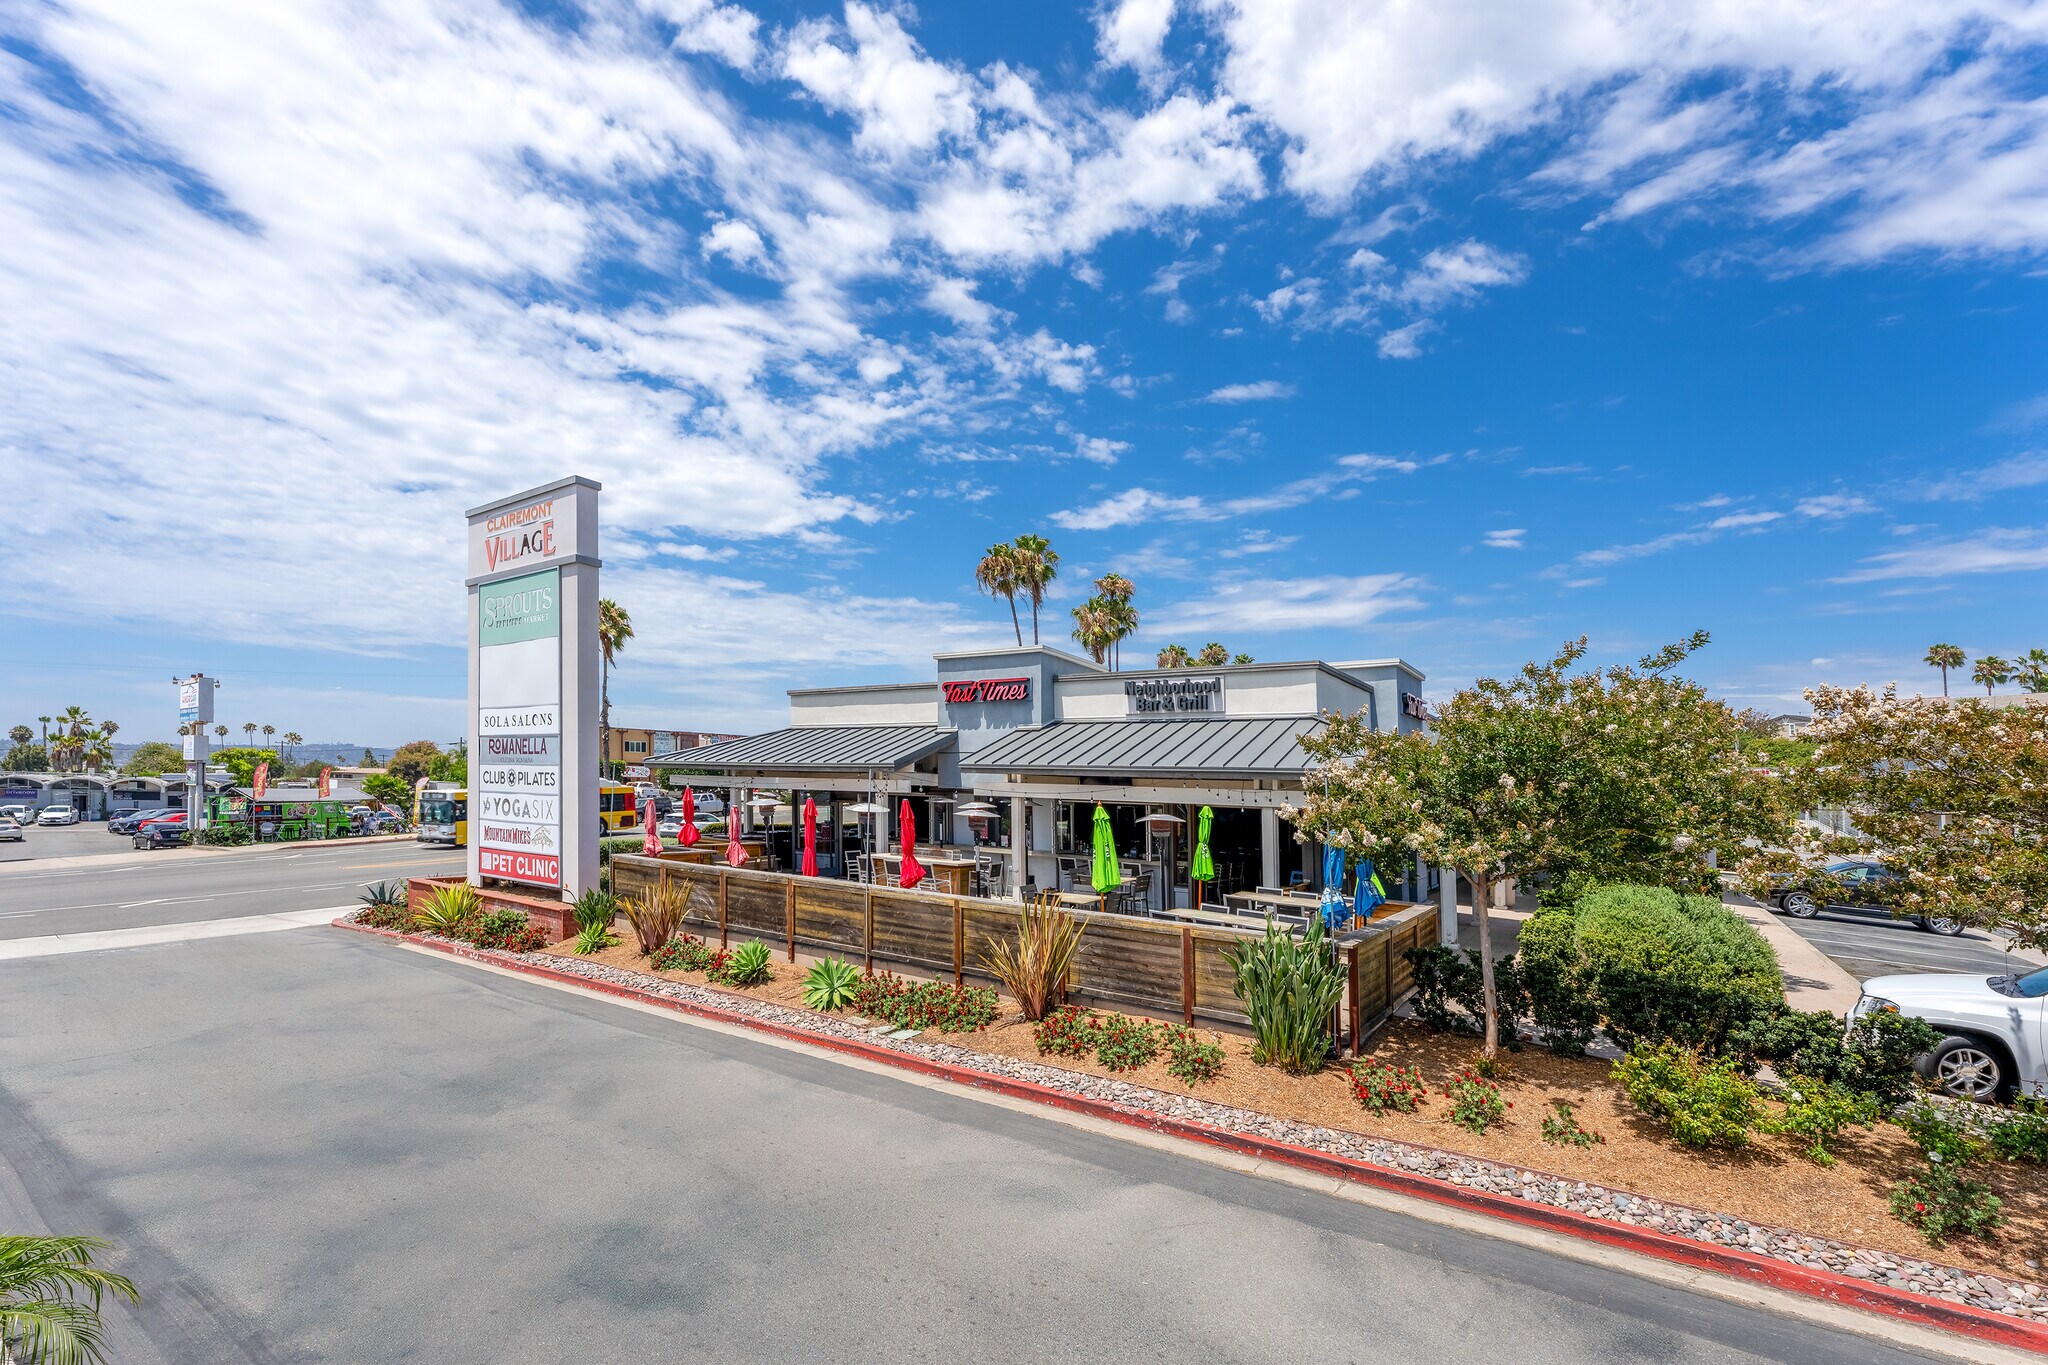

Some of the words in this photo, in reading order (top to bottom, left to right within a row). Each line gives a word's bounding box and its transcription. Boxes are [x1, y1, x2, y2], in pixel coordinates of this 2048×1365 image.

[486, 500, 554, 533] CLAIREMONT
[484, 520, 557, 573] VILLAGE
[484, 587, 552, 628] SPROUTS
[942, 680, 978, 703] Fast
[977, 677, 1030, 702] Times
[1124, 677, 1221, 699] Neighborhood
[1136, 696, 1161, 711] Bar
[1161, 696, 1175, 711] &
[1177, 695, 1209, 711] Grill
[484, 715, 510, 728] SOLA
[511, 713, 553, 727] SALONS
[488, 737, 548, 755] ROMANELLA
[483, 770, 506, 784] CLUB
[518, 771, 556, 787] PILATES
[484, 825, 512, 842] MOUNTAIN
[512, 826, 531, 845] MIKE'S
[492, 853, 514, 873] PET
[516, 856, 558, 880] CLINIC
